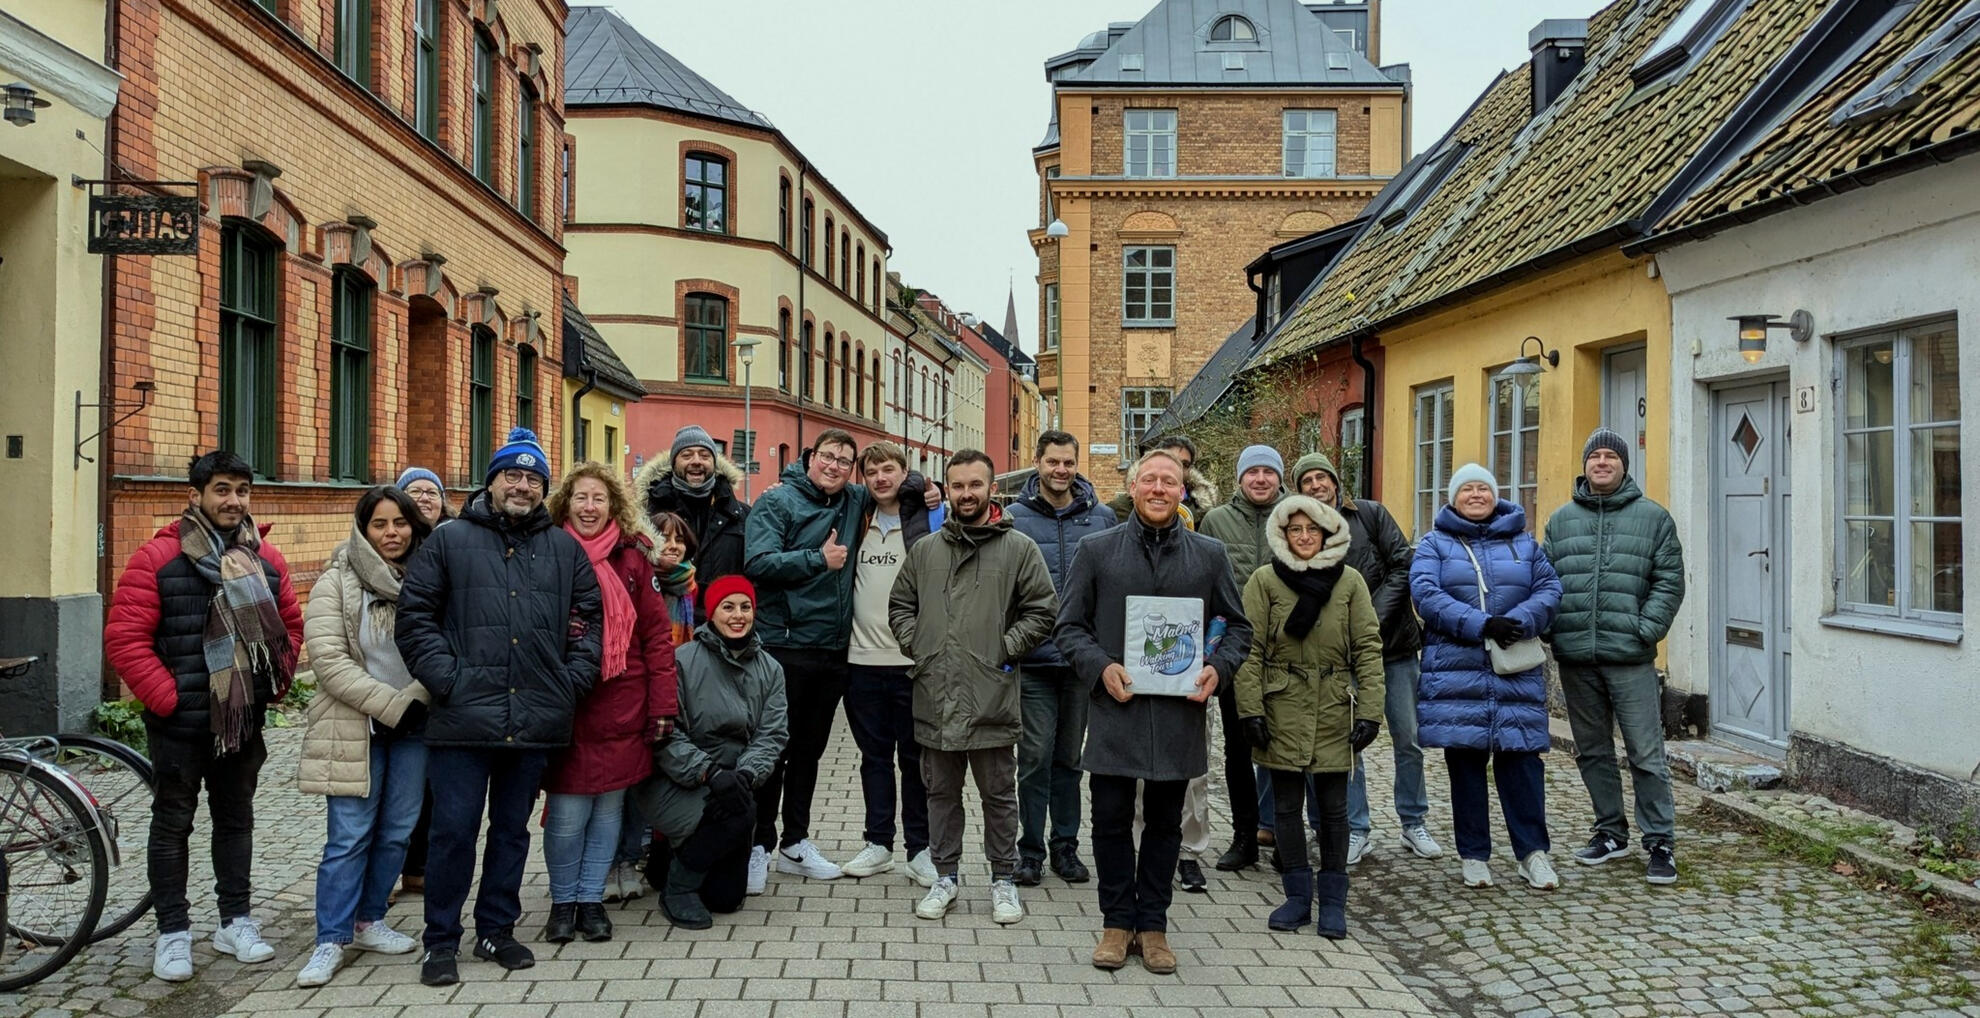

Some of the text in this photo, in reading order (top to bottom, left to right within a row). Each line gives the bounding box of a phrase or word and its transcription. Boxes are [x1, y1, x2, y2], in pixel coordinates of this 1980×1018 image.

[1638, 397, 1646, 418] 6
[1800, 390, 1807, 408] 8
[860, 550, 898, 564] Levi's
[1152, 620, 1200, 640] Malmö
[1139, 651, 1176, 667] Walking
